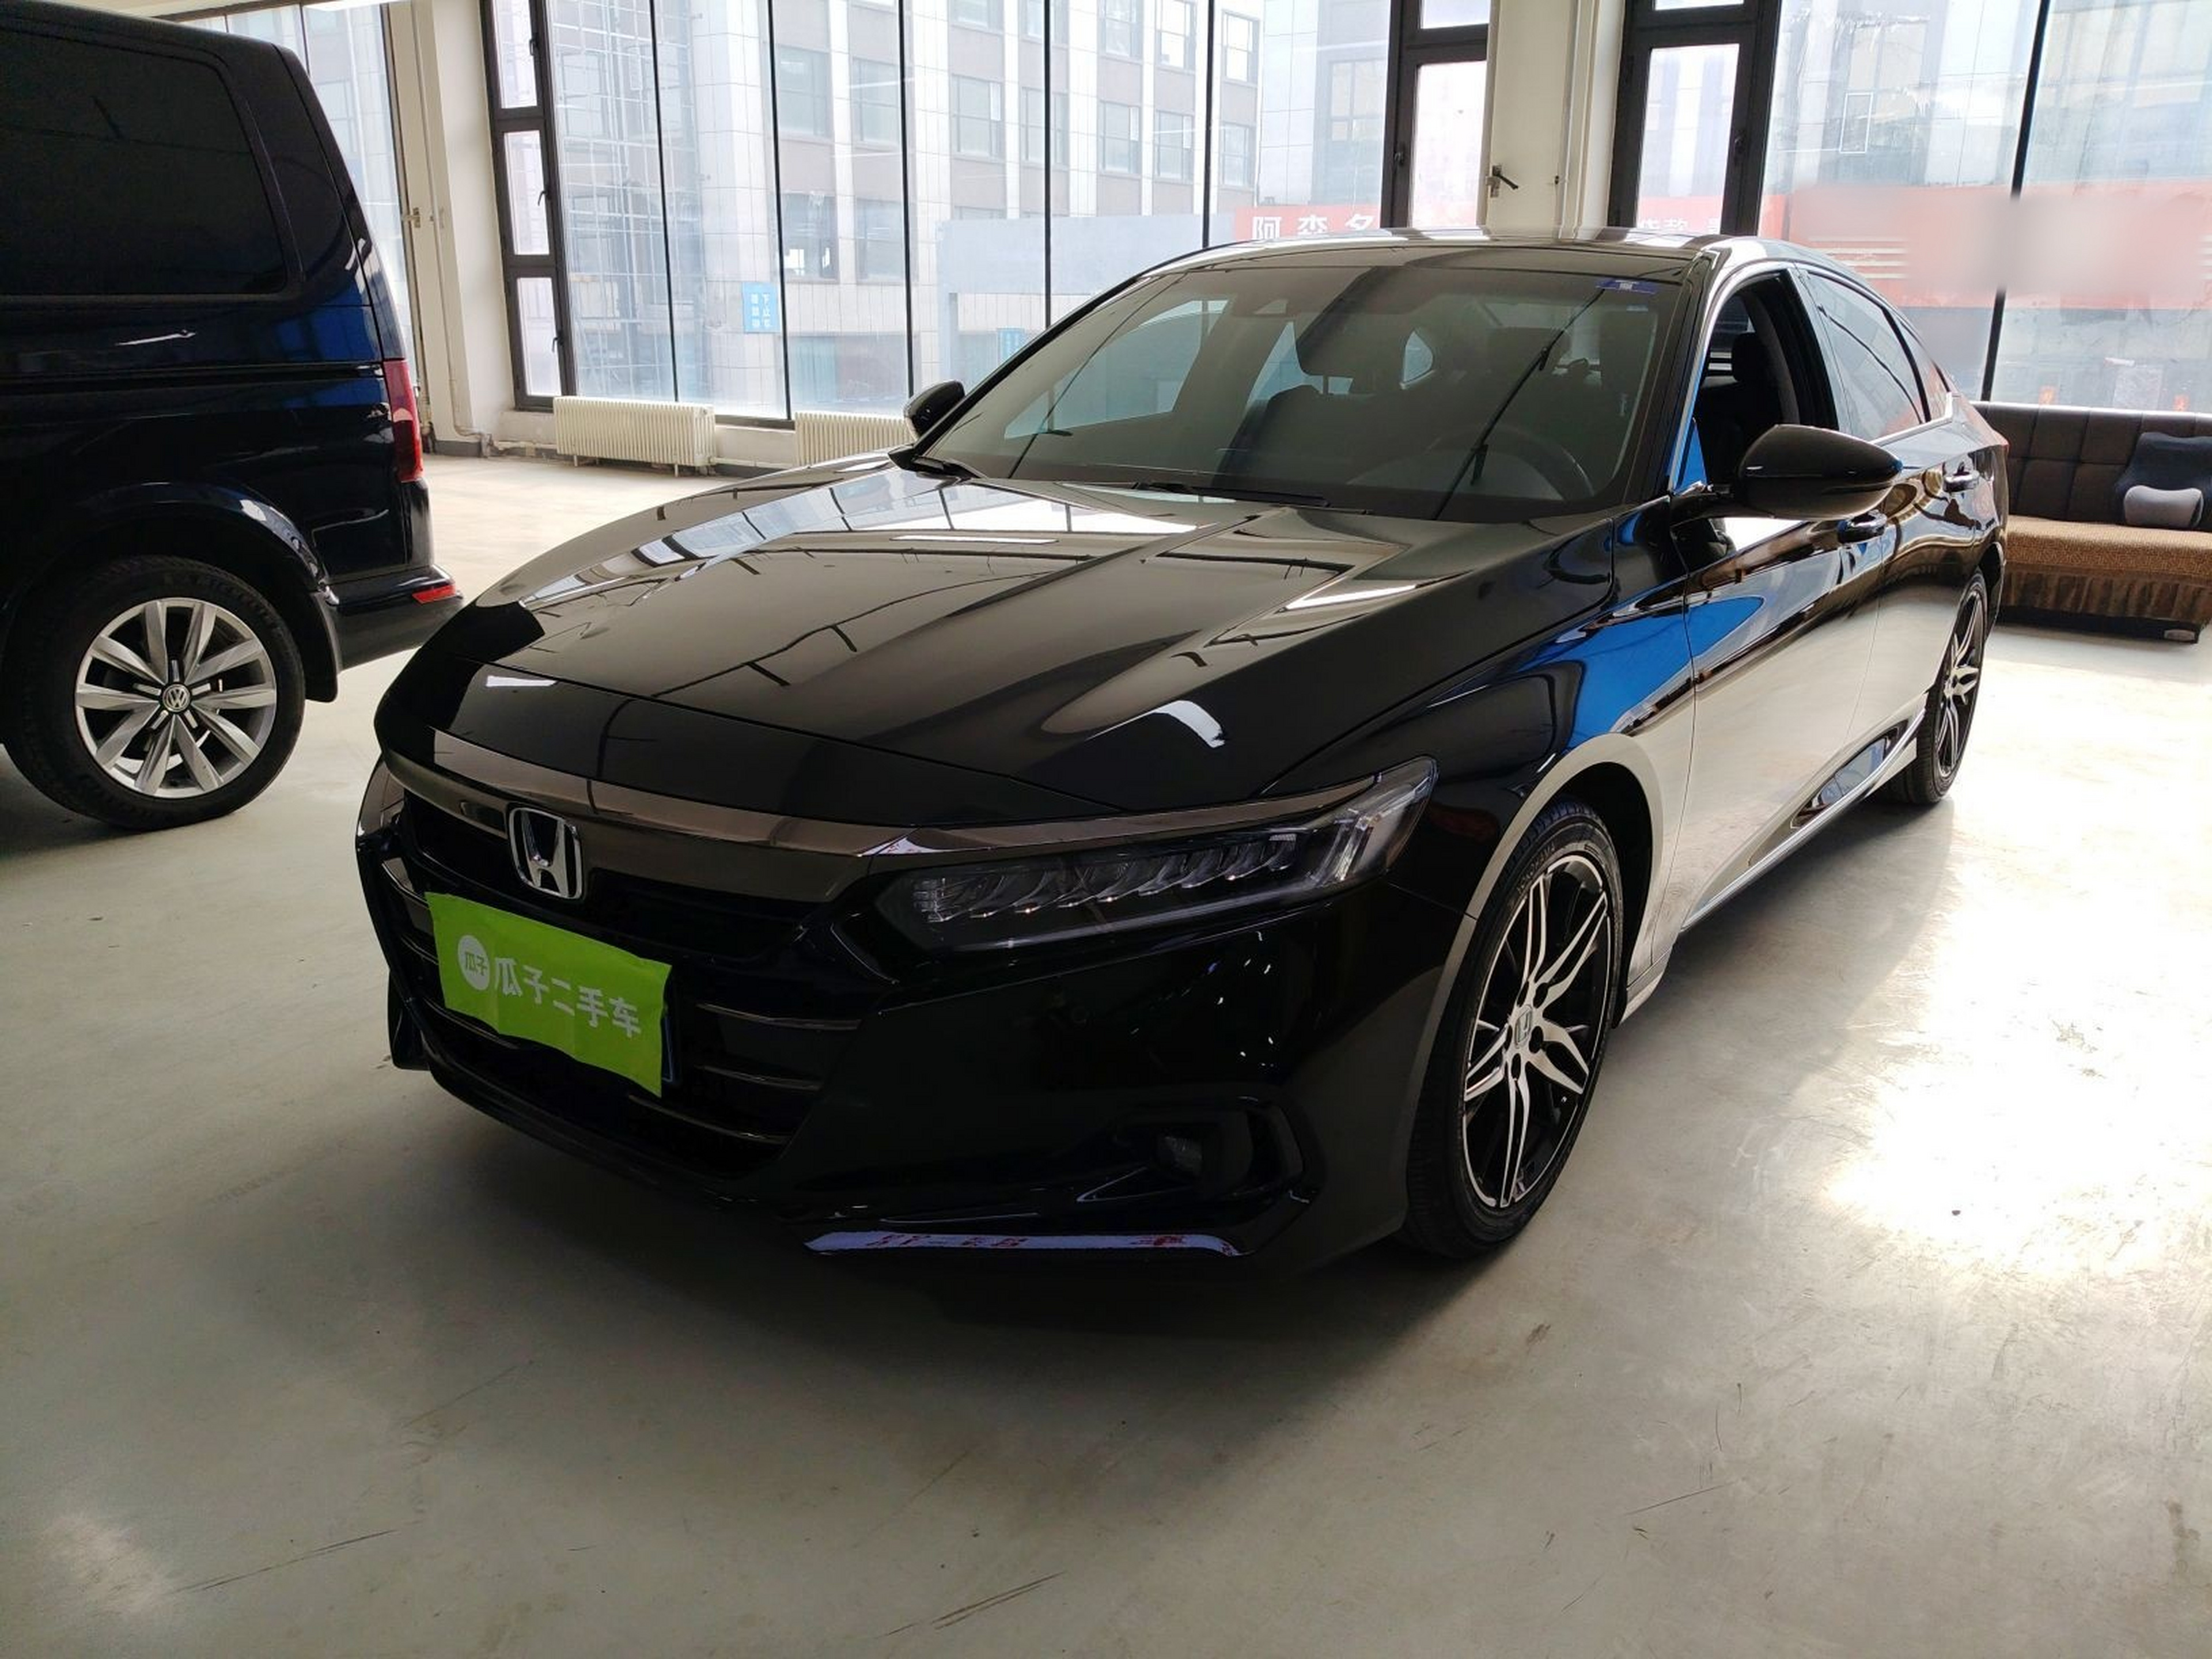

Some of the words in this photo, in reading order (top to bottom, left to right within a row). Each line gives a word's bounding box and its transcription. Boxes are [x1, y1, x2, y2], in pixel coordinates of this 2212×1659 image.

[465, 953, 488, 975] 瓜子
[494, 957, 641, 1039] 瓜子二手车
